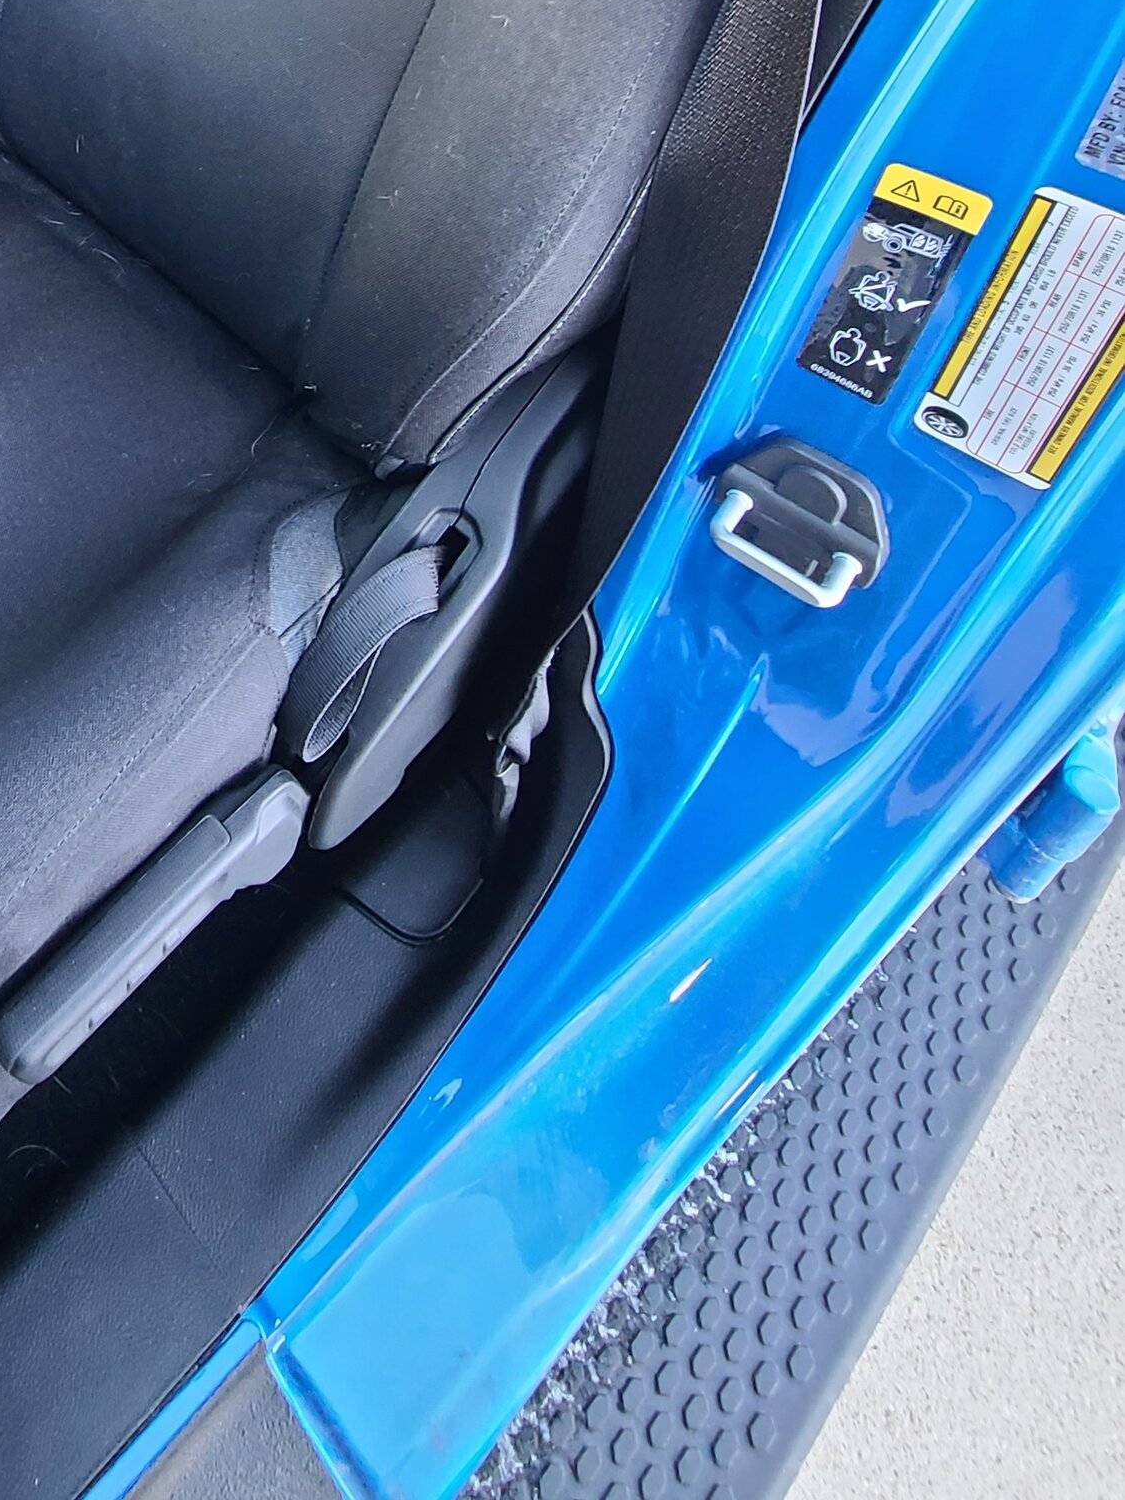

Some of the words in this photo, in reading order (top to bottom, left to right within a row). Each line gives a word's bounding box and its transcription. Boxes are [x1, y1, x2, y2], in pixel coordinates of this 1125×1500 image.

[1083, 132, 1111, 159] MFD
[1097, 111, 1123, 132] BY:
[988, 247, 1019, 291] INFORMATION
[1071, 249, 1088, 267] SPARE
[1090, 244, 1115, 276] 255/70R18
[974, 290, 996, 317] LOADING
[1047, 292, 1062, 308] REAR
[1056, 303, 1081, 334] 255/70R18
[1074, 289, 1089, 304] 113T
[967, 315, 982, 329] AND
[960, 328, 975, 344] TIRE
[1016, 345, 1031, 362] FRONT
[1046, 444, 1059, 455] SEE
[1064, 405, 1083, 426] MANUAL
[1076, 394, 1090, 406] FOR
[1083, 366, 1107, 395] ADDITIONAL
